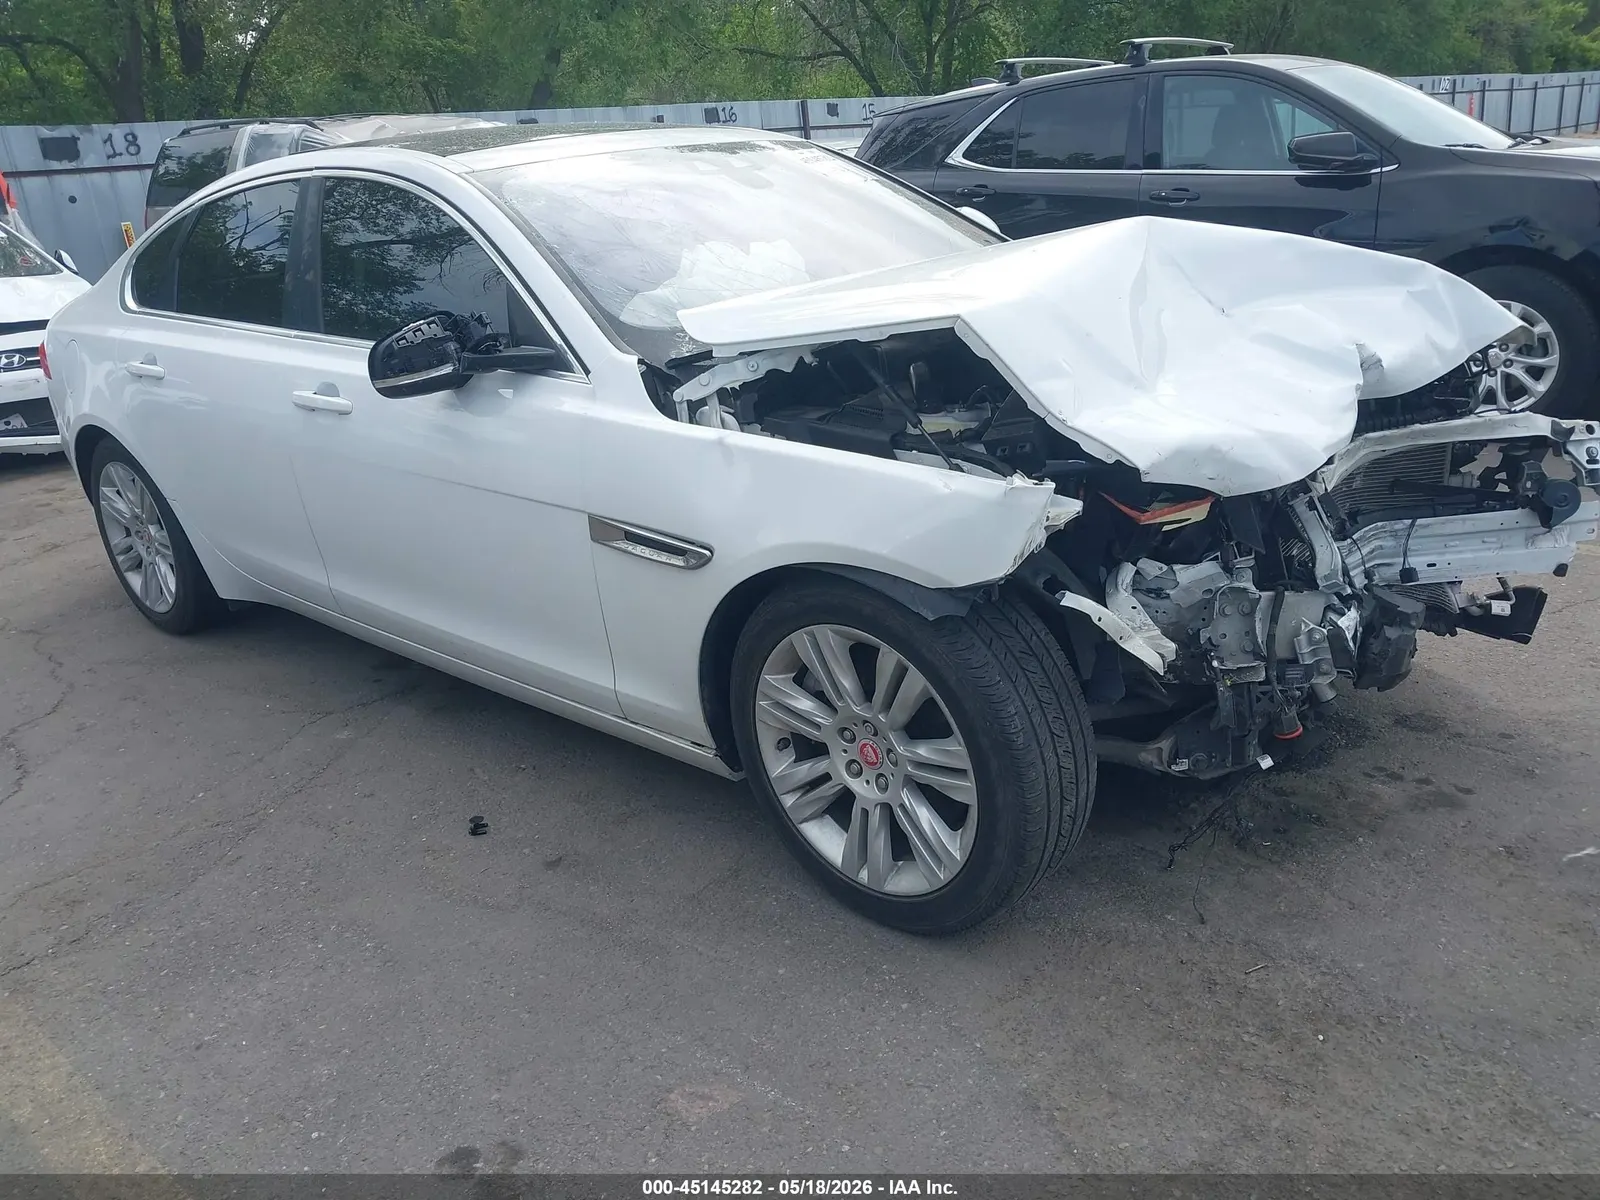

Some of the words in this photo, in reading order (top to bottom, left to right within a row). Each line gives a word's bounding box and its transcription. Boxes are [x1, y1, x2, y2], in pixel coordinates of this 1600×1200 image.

[721, 106, 738, 124] 16
[103, 132, 141, 160] 18
[623, 541, 673, 563] JAGUAR
